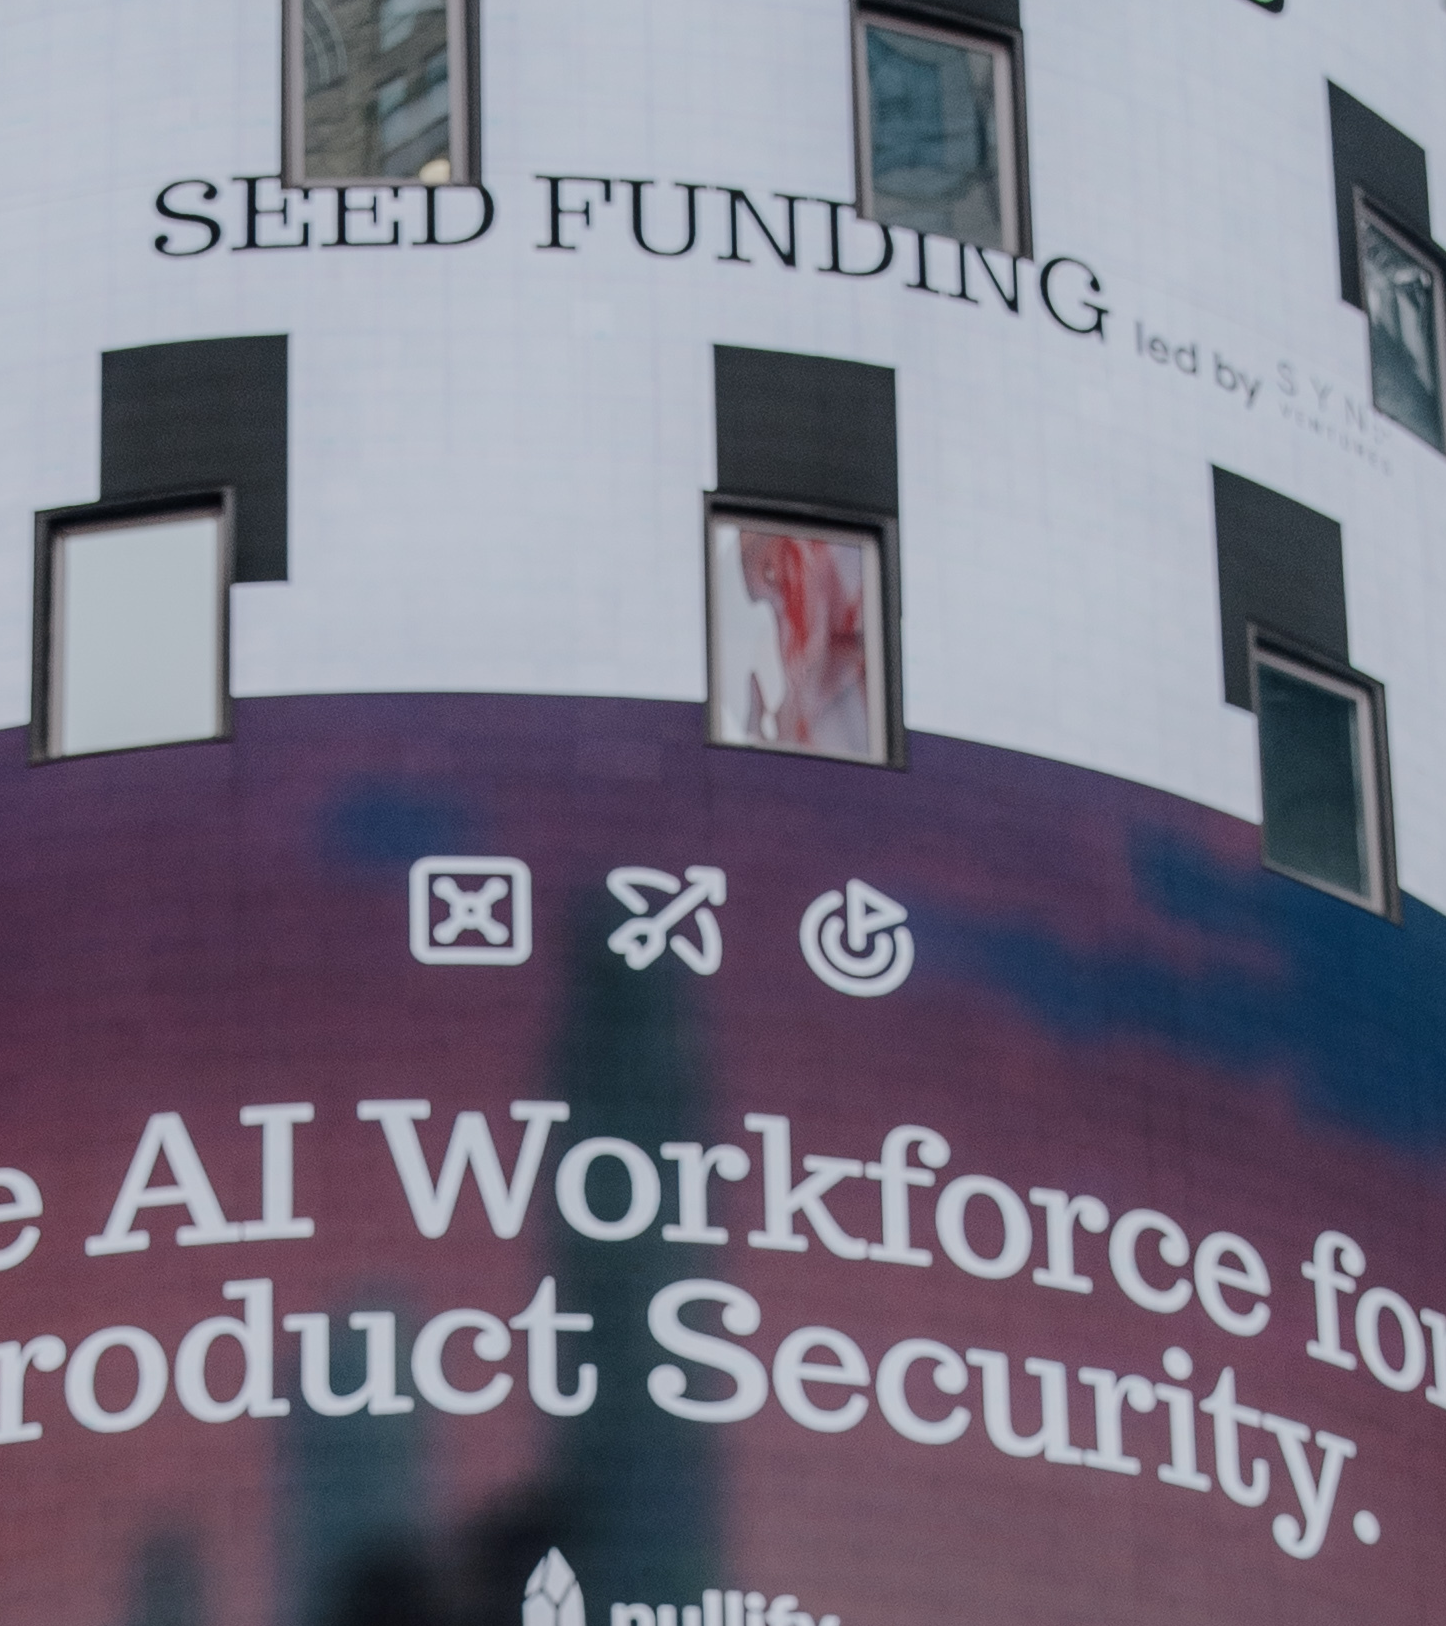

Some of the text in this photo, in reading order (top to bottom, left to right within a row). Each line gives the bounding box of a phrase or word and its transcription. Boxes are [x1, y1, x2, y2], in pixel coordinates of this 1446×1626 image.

[153, 173, 1111, 342] SEED FUNDING
[1133, 320, 1199, 377] led
[1211, 350, 1263, 410] by
[85, 1099, 316, 1259] AI
[356, 1096, 1272, 1340] Workforce
[646, 1276, 1384, 1561] Security.
